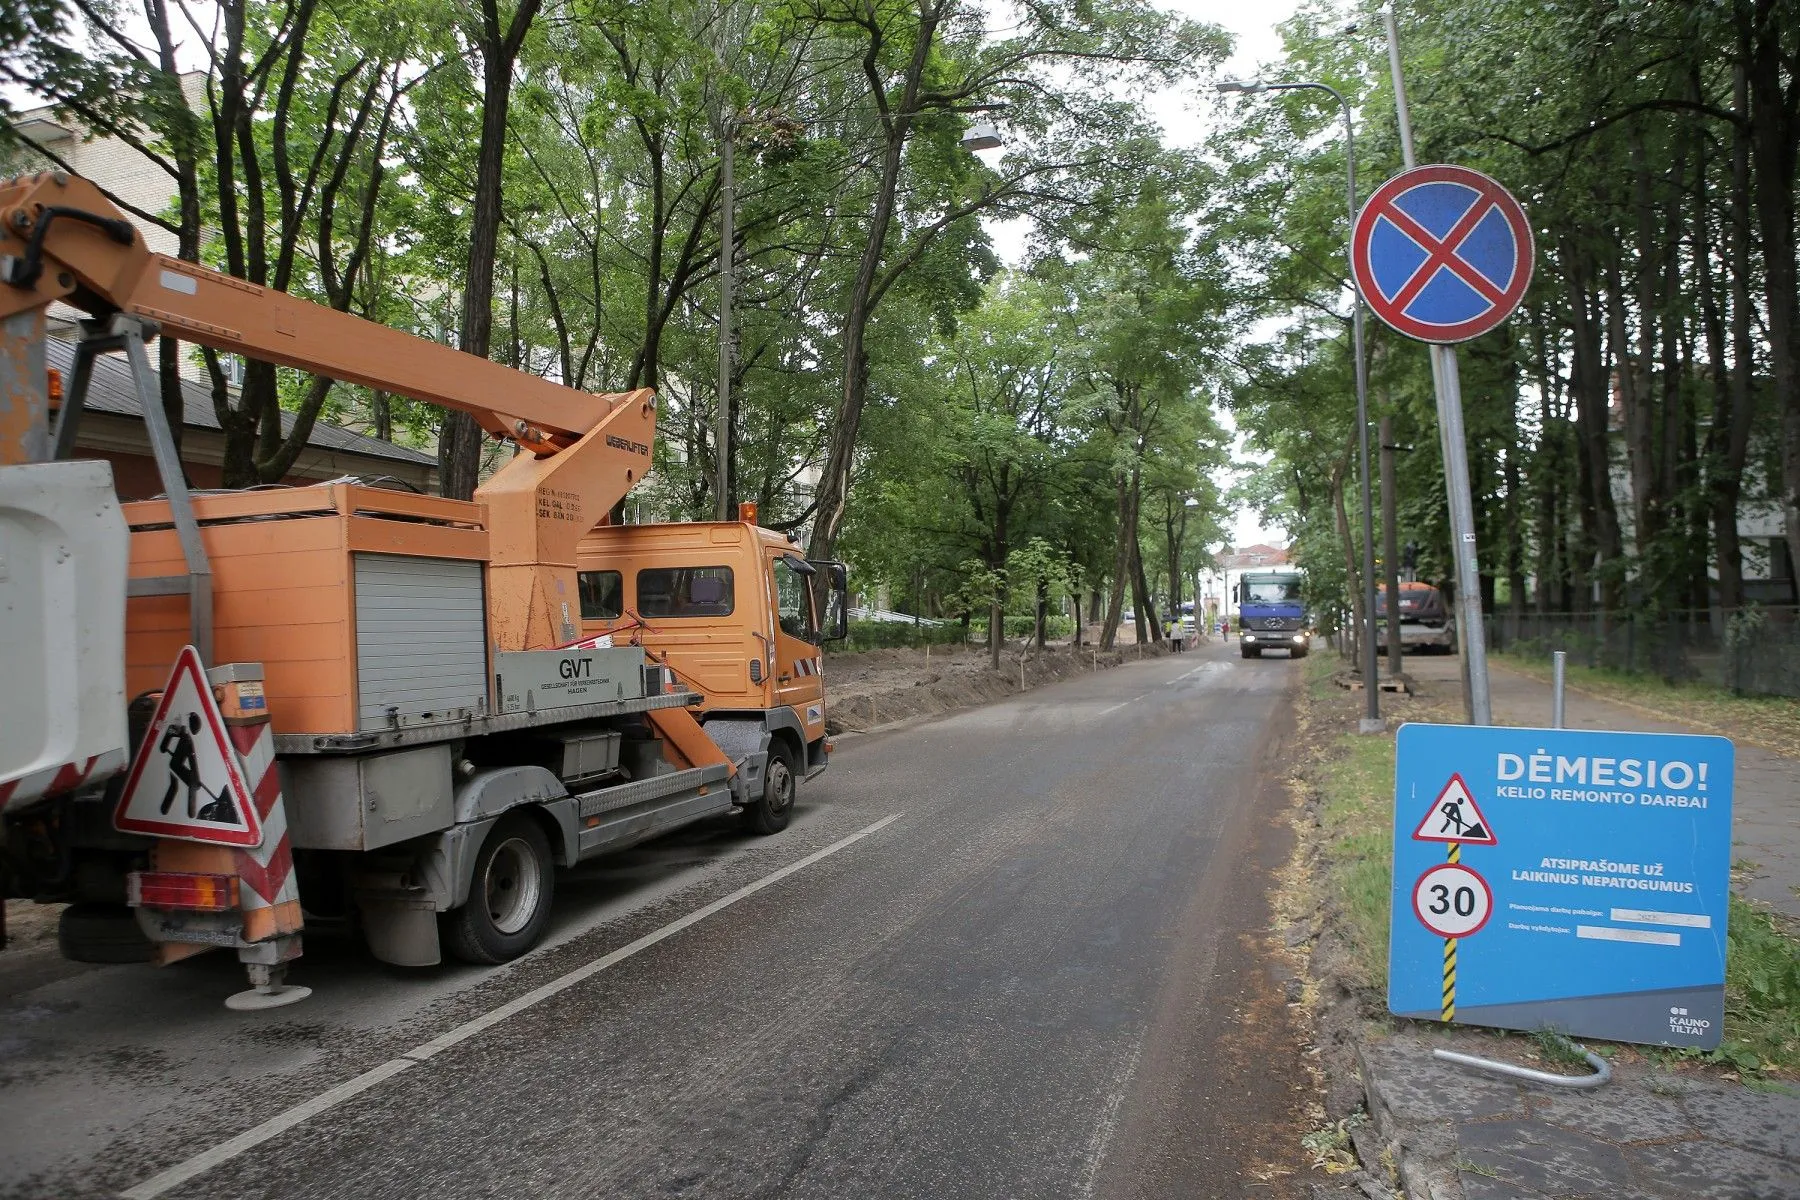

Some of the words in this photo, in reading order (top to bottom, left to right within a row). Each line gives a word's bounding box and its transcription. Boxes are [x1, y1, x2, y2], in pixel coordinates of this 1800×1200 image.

[560, 658, 593, 679] GVT
[541, 681, 569, 690] GESELLSCHAFT
[1497, 748, 1708, 791] DĖMESIO!
[1496, 785, 1546, 800] KELIO
[1550, 788, 1636, 805] REMONTO
[1640, 793, 1708, 809] DARBAI
[1540, 857, 1640, 875] ATSIPRAŠOME
[1643, 863, 1664, 877] UŽ
[1512, 869, 1579, 885] LAIKINUS
[1582, 875, 1694, 894] NEPATOGUMUS
[1429, 884, 1475, 917] 30
[1669, 1016, 1710, 1028] KAUNO
[1669, 1024, 1703, 1035] TILTAI
